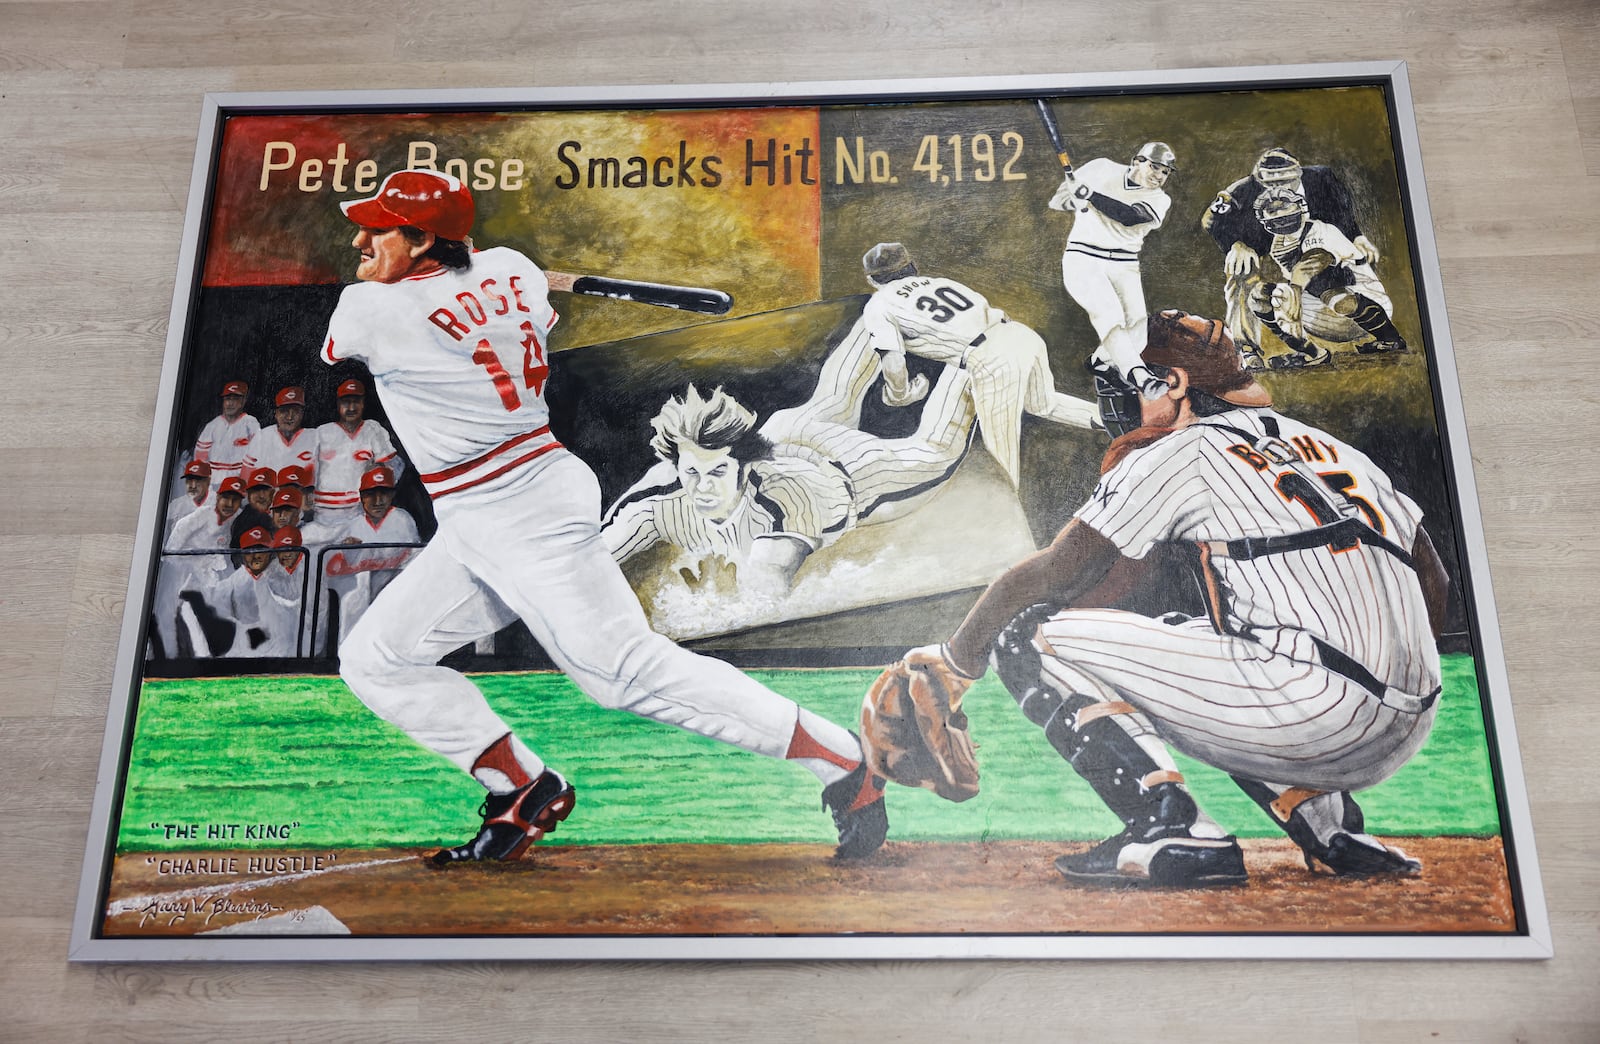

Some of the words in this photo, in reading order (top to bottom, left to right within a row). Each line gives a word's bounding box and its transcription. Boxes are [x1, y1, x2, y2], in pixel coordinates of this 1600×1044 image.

[259, 141, 378, 192] Pete
[555, 140, 723, 190] Smacks
[745, 138, 817, 186] Hit
[835, 136, 899, 185] No.
[912, 131, 1028, 187] 4,192
[427, 275, 530, 342] ROSE
[896, 279, 931, 299] SHOW
[916, 286, 975, 324] 30
[471, 320, 549, 413] 14
[1226, 434, 1340, 473] BHY
[207, 824, 241, 840] HIT
